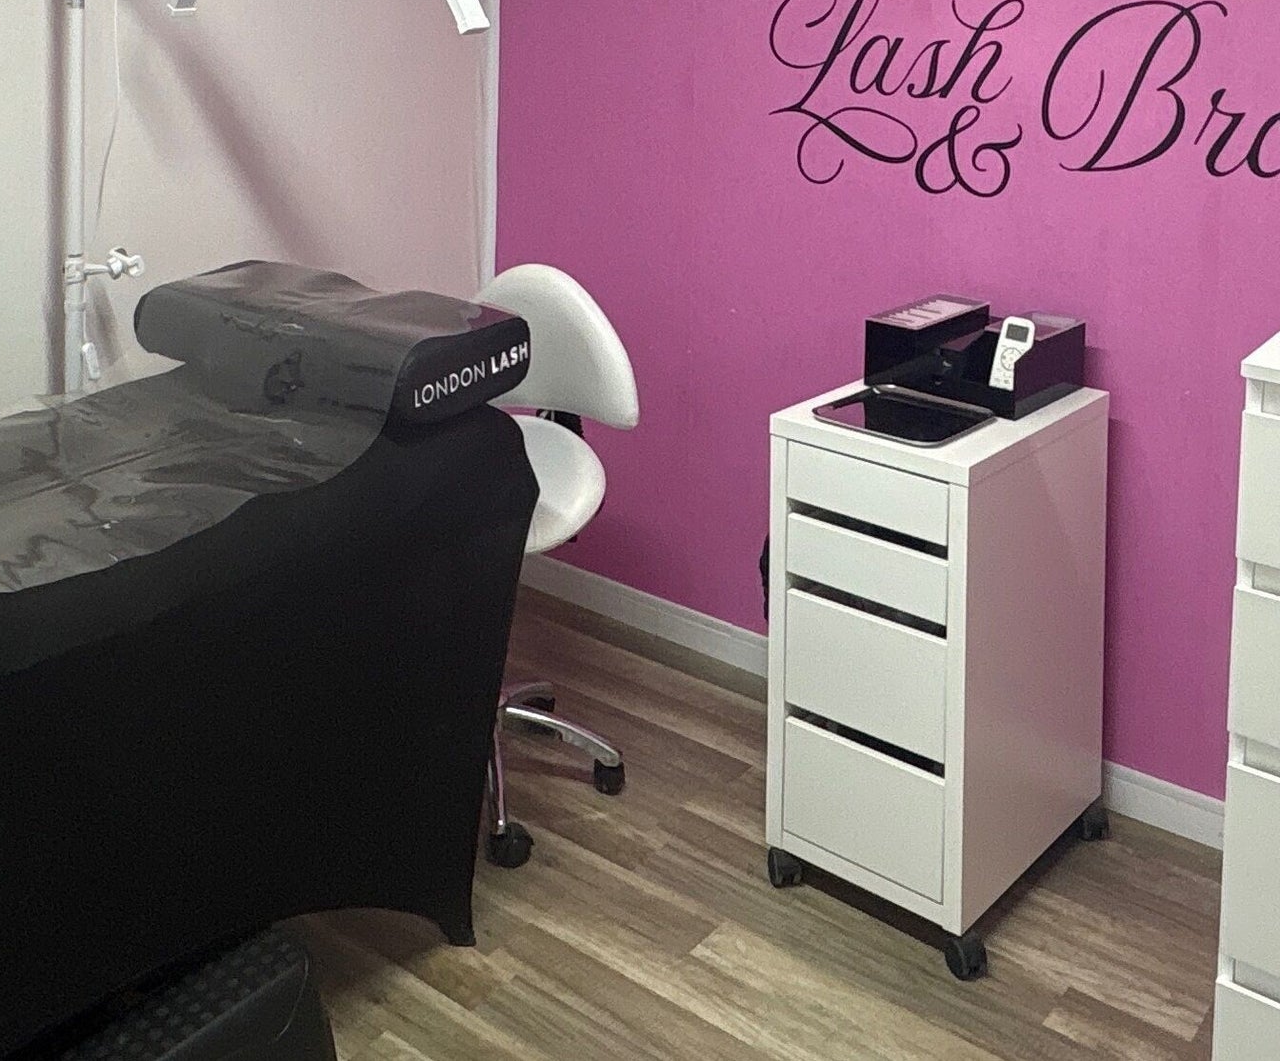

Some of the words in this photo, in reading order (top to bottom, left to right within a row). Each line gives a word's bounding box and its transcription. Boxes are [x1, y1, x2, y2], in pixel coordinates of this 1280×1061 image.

[913, 105, 1023, 198] &
[413, 360, 486, 408] LONDON
[490, 341, 529, 375] LASH
